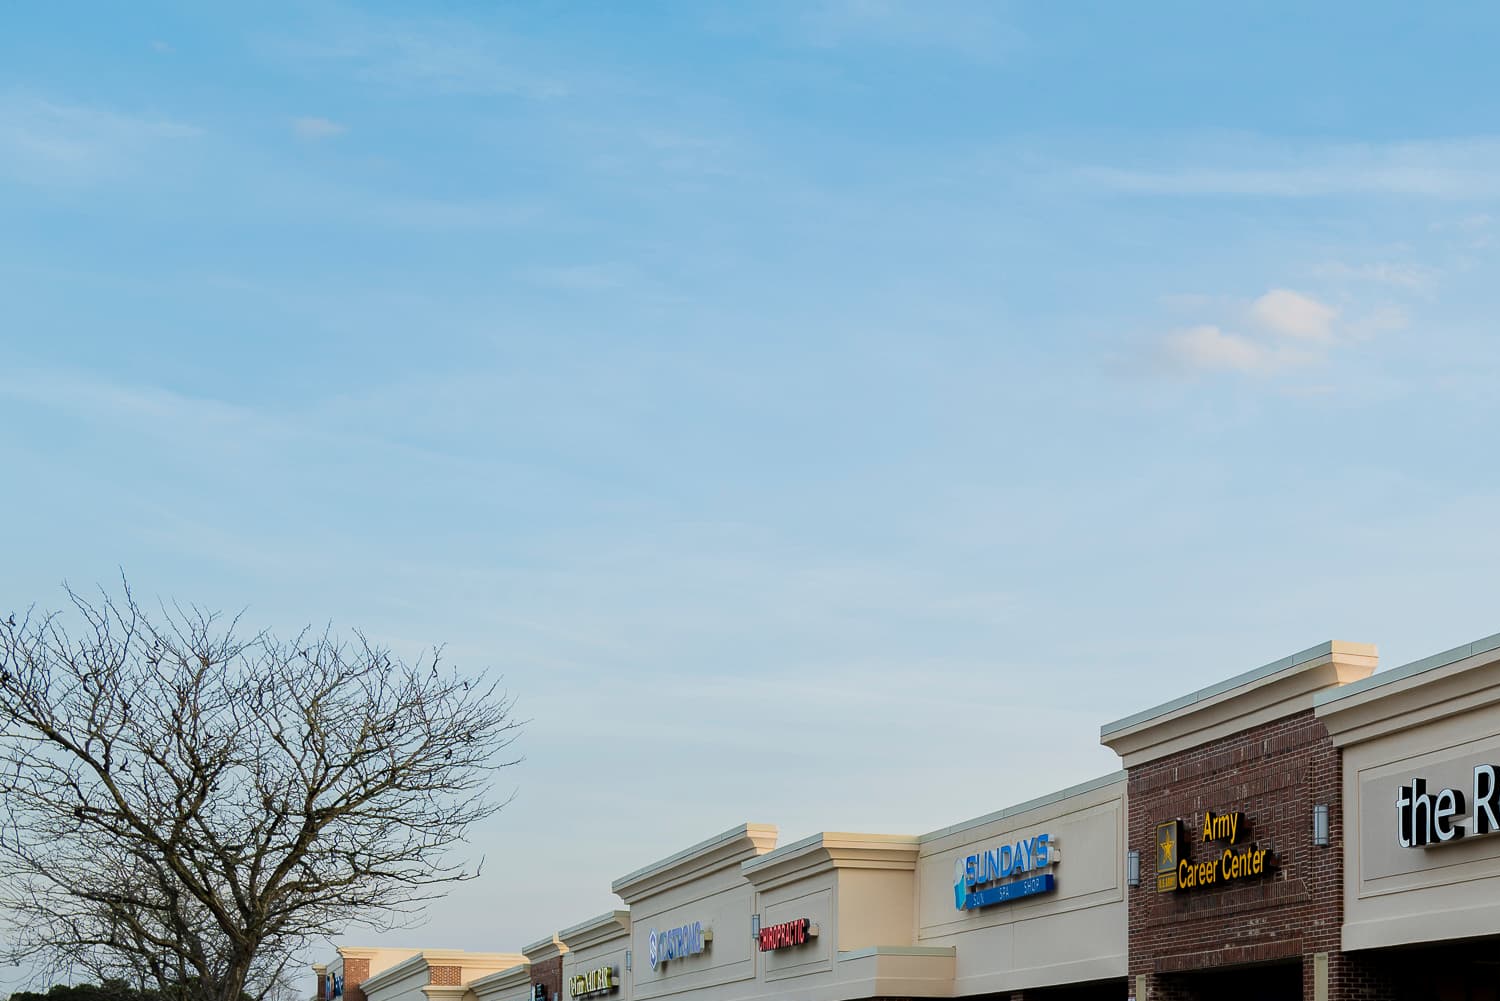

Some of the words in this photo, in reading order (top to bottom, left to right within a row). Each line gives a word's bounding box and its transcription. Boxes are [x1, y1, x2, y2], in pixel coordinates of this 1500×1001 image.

[1202, 811, 1239, 845] Army
[1396, 778, 1458, 848] the
[966, 833, 1050, 888] SUNDAYS
[1179, 858, 1219, 889] Career
[1222, 848, 1266, 881] Center
[760, 918, 805, 951] CHIROPRACTIC
